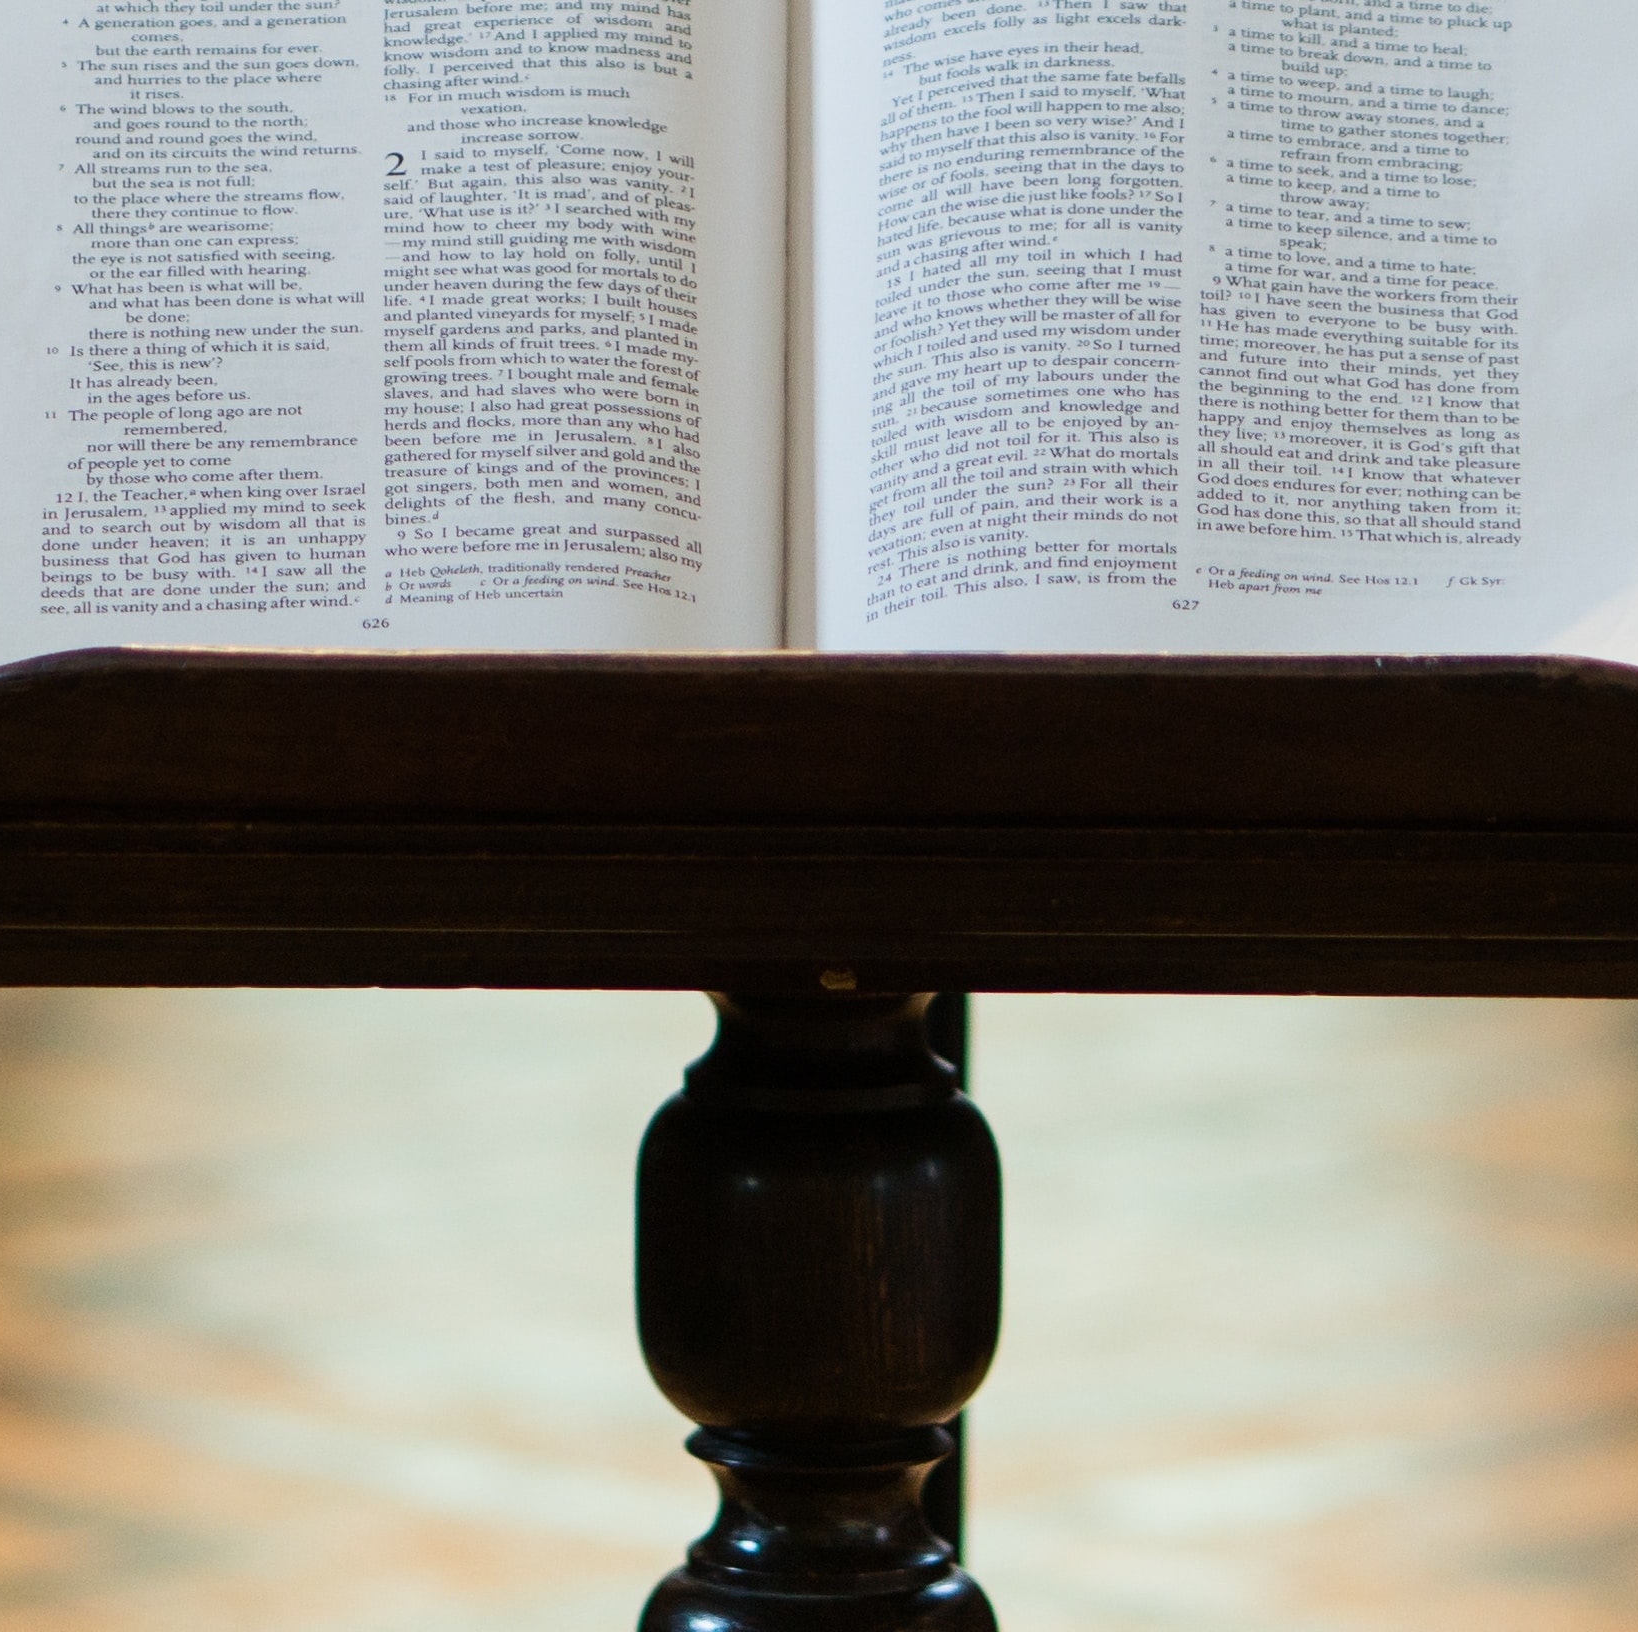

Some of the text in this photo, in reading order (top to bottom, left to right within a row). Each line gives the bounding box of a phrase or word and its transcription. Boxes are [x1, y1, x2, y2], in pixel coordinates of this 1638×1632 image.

[96, 4, 110, 14] at
[114, 0, 160, 13] which
[164, 1, 196, 16] they
[200, 1, 224, 13] toil
[229, 0, 273, 12] under
[277, 0, 301, 11] the
[1281, 17, 1318, 31] what
[1322, 22, 1334, 32] is
[95, 44, 120, 57] but
[125, 44, 149, 57] the
[152, 44, 191, 56] earth
[196, 46, 258, 56] remains
[262, 43, 284, 55] for
[919, 72, 942, 86] but
[946, 64, 981, 80] fools
[985, 59, 1019, 73] walk
[1023, 61, 1039, 70] in
[407, 114, 668, 135] and those who increase knowledge
[461, 133, 524, 144] increase
[384, 152, 407, 176] 2
[1280, 191, 1324, 205] throw
[87, 434, 358, 452] nor will there be any remembrance
[869, 462, 1179, 514] get from all the toil and strain with which
[1197, 471, 1230, 486] God
[1233, 473, 1269, 488] does
[1272, 477, 1336, 493] endures
[1339, 481, 1362, 495] for
[1406, 485, 1469, 499] nothing
[1471, 490, 1499, 499] can
[1503, 487, 1521, 499] be
[384, 495, 446, 512] delights
[455, 493, 471, 506] of
[480, 492, 505, 506] the
[565, 492, 595, 504] and
[603, 496, 646, 512] many
[897, 546, 928, 562] This
[931, 539, 961, 553] also
[963, 535, 976, 546] is
[1172, 599, 1200, 610] 627
[362, 618, 390, 629] 626
